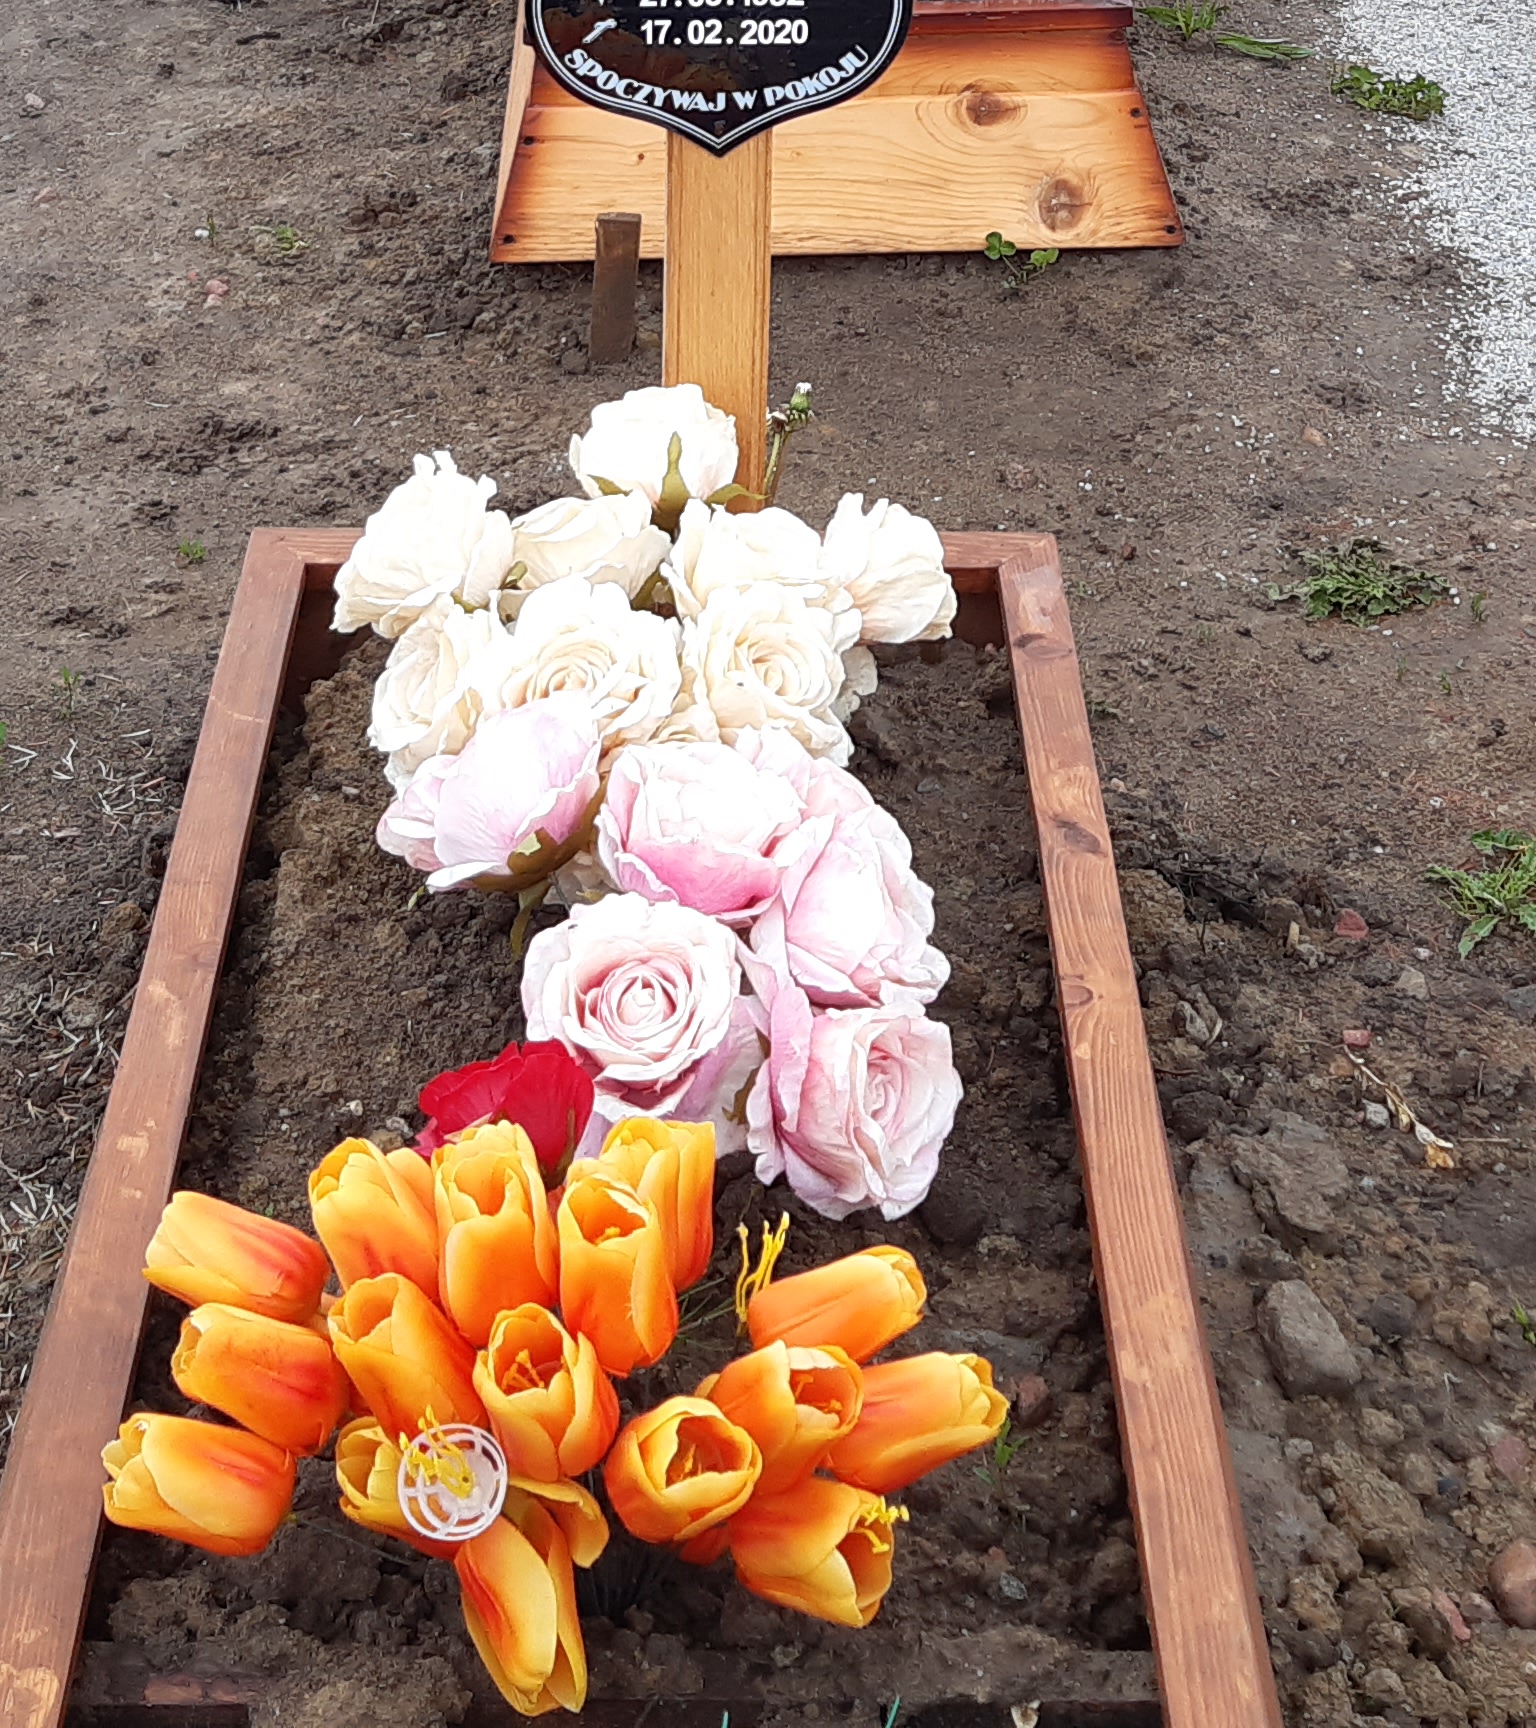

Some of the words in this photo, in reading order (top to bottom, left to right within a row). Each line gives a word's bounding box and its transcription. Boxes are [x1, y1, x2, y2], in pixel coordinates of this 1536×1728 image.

[640, 19, 809, 45] 17.02.2020
[564, 48, 726, 112] SPOCZYWAJ
[732, 90, 757, 110] W
[764, 44, 869, 107] POKOJU
